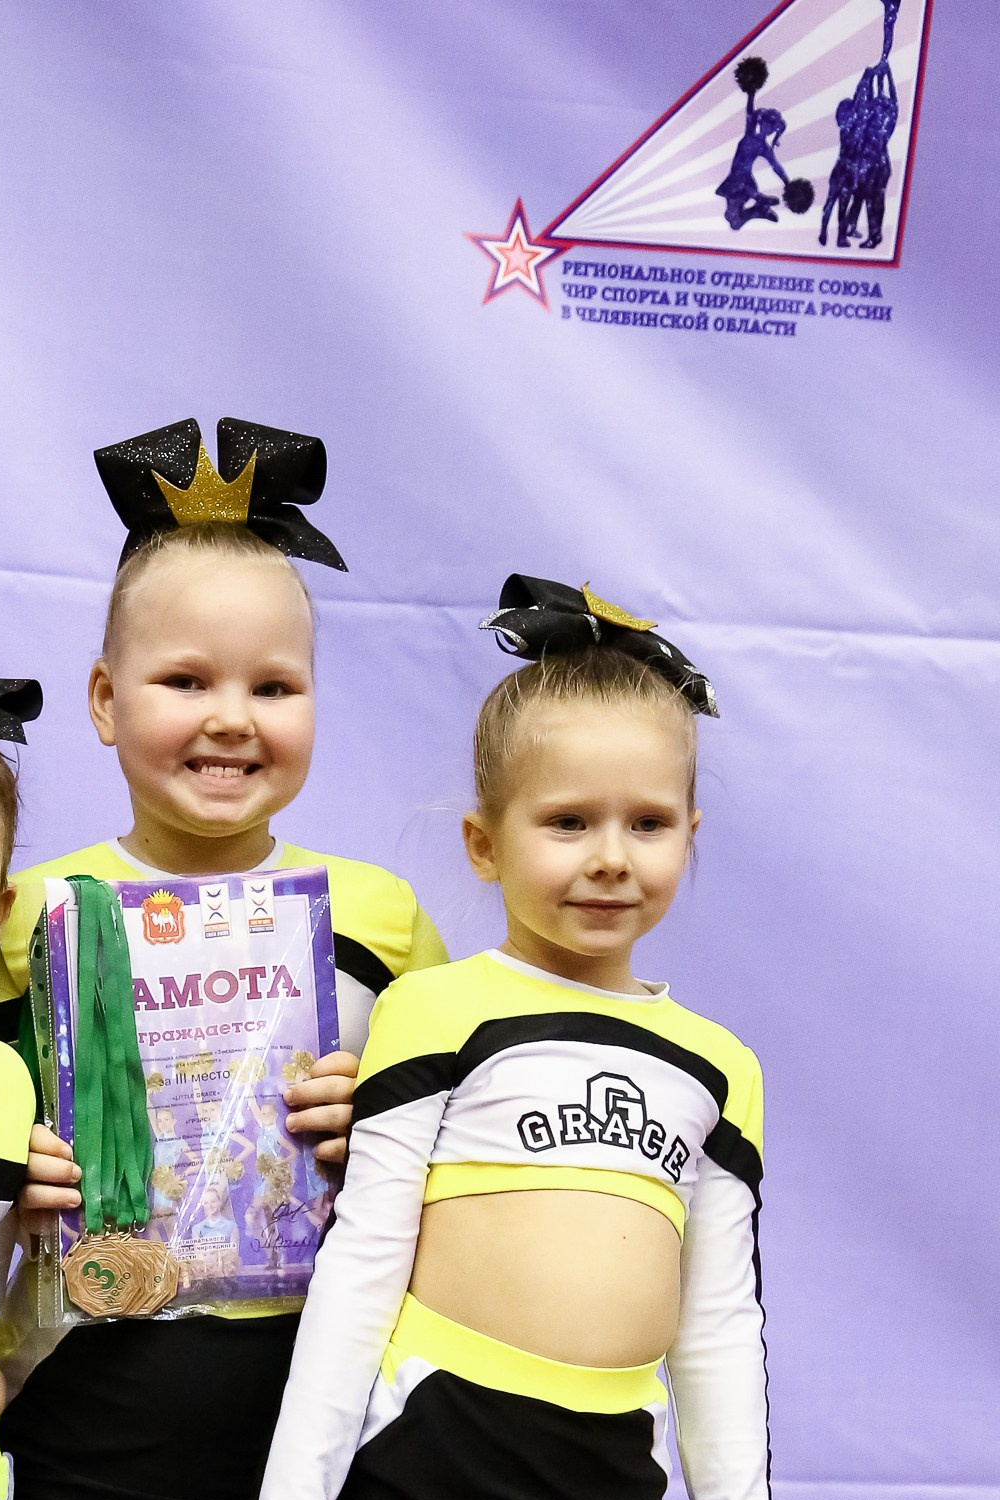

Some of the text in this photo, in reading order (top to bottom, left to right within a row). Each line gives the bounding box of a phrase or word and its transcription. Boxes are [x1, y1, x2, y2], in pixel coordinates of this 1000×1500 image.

[562, 260, 883, 298] РЕГИОНАЛЬНОЕ ОТДЕЛЕНИЕ СОЮЗА
[562, 282, 892, 321] ЧИР СПОРТА И ЧИРЛИДИНГА РОССИИ
[561, 304, 797, 336] В ЧЕЛЯБИНСКОЙ ОБЛАСТИ
[133, 965, 302, 1012] АМОТА
[138, 1020, 268, 1046] граждается
[191, 1070, 231, 1083] место
[517, 1103, 690, 1184] GRACE
[83, 1260, 116, 1290] 3
